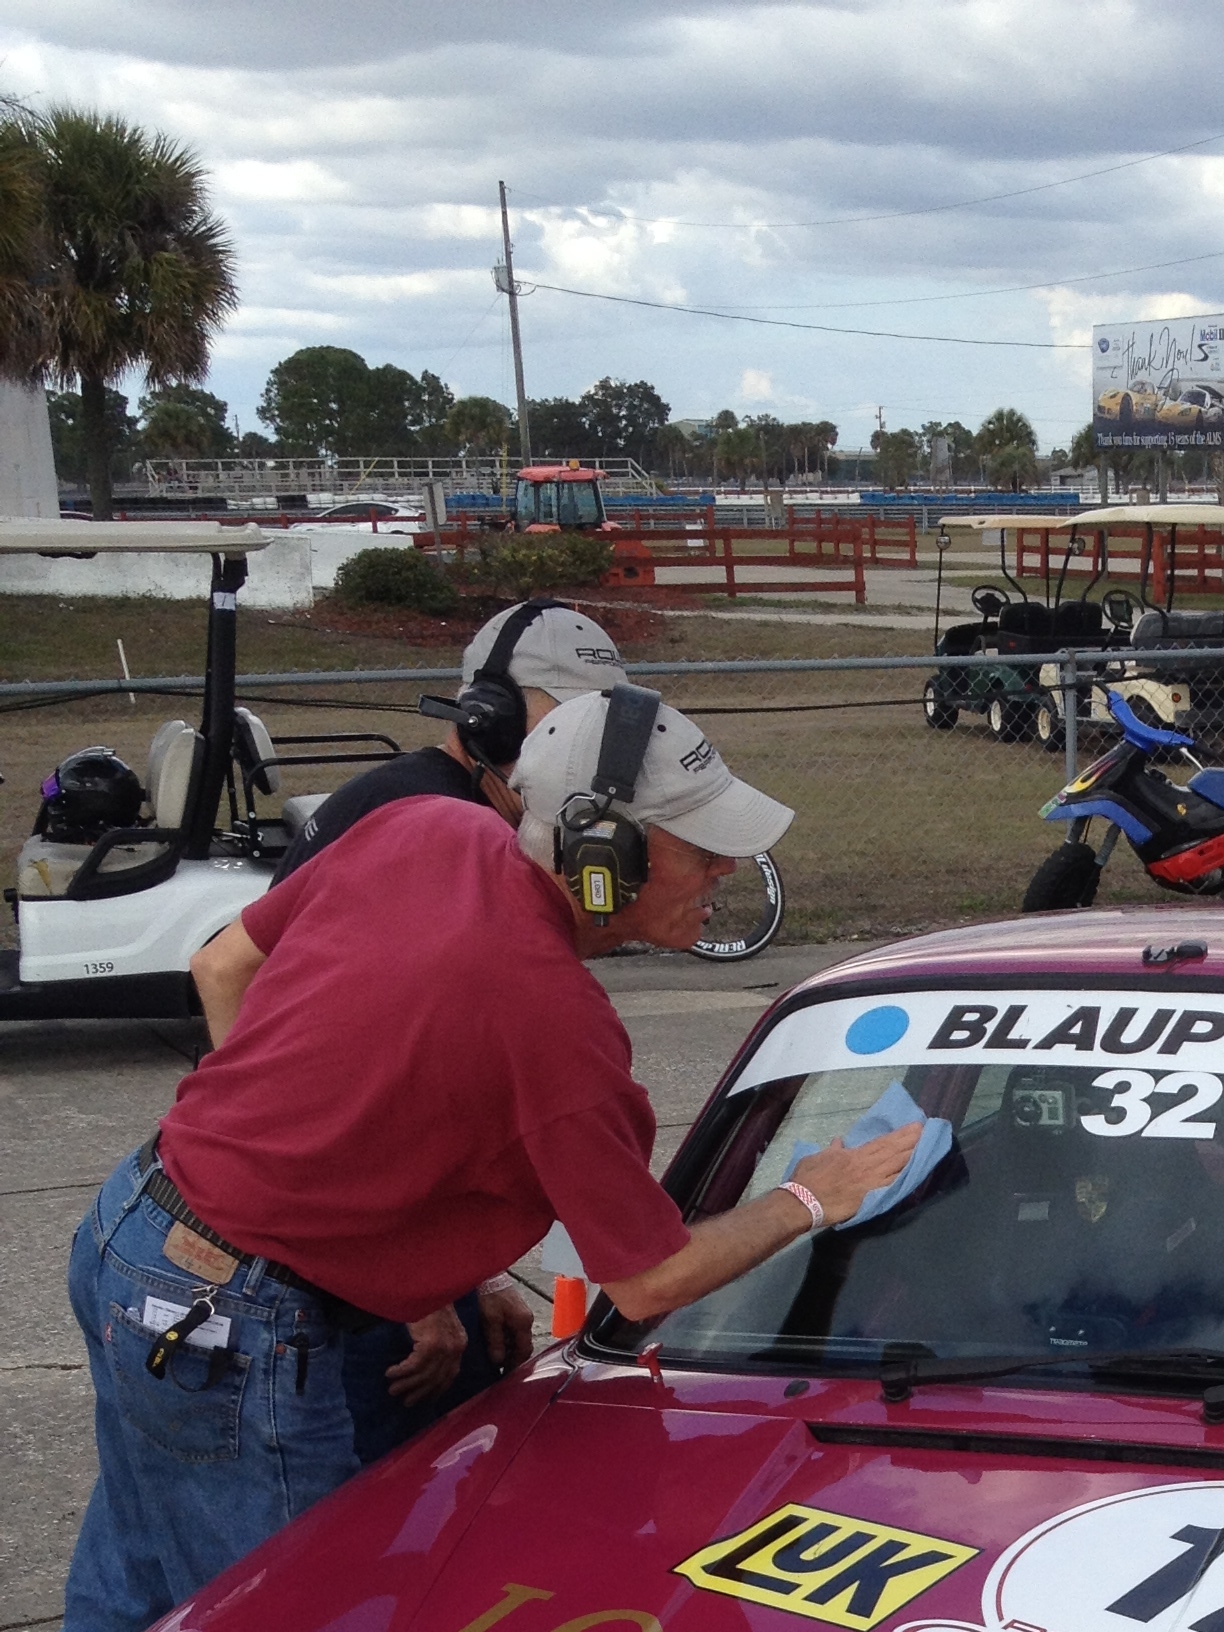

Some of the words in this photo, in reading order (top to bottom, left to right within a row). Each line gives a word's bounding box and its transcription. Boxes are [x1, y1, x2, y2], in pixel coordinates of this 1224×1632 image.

[1200, 329, 1217, 341] Mobil
[1097, 432, 1113, 446] Thank
[1113, 434, 1122, 448] you
[1122, 432, 1132, 446] fans
[1140, 433, 1168, 449] supporting
[1175, 433, 1189, 449] years
[1189, 431, 1196, 445] of
[1196, 431, 1205, 445] the
[83, 961, 114, 975] 1359
[1080, 1069, 1223, 1139] 32
